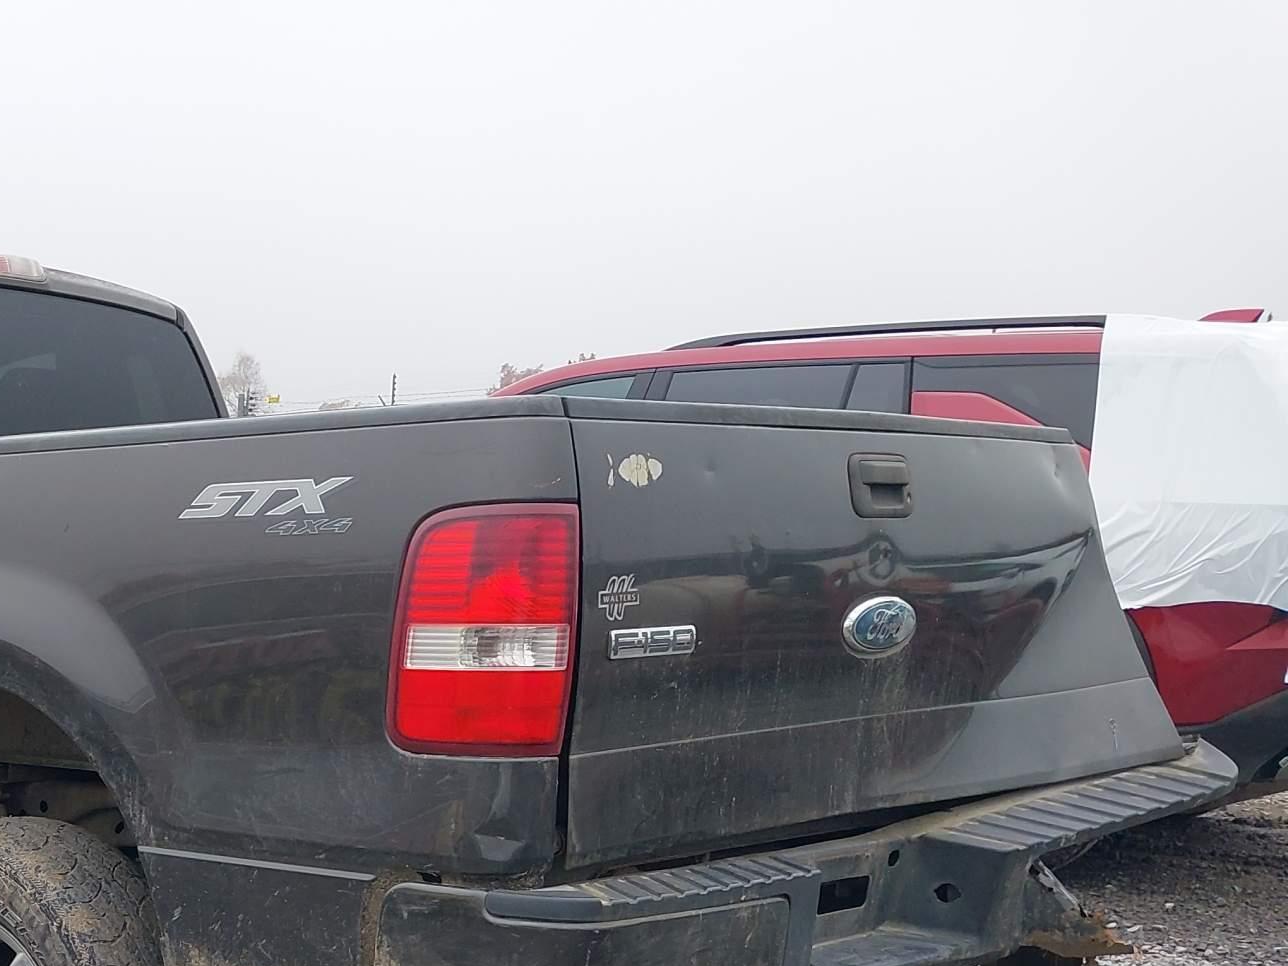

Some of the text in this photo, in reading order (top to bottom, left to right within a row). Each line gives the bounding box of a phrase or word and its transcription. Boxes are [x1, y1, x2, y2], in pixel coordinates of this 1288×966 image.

[178, 475, 354, 520] STX
[602, 592, 637, 604] WALTERS
[866, 604, 905, 641] Ford
